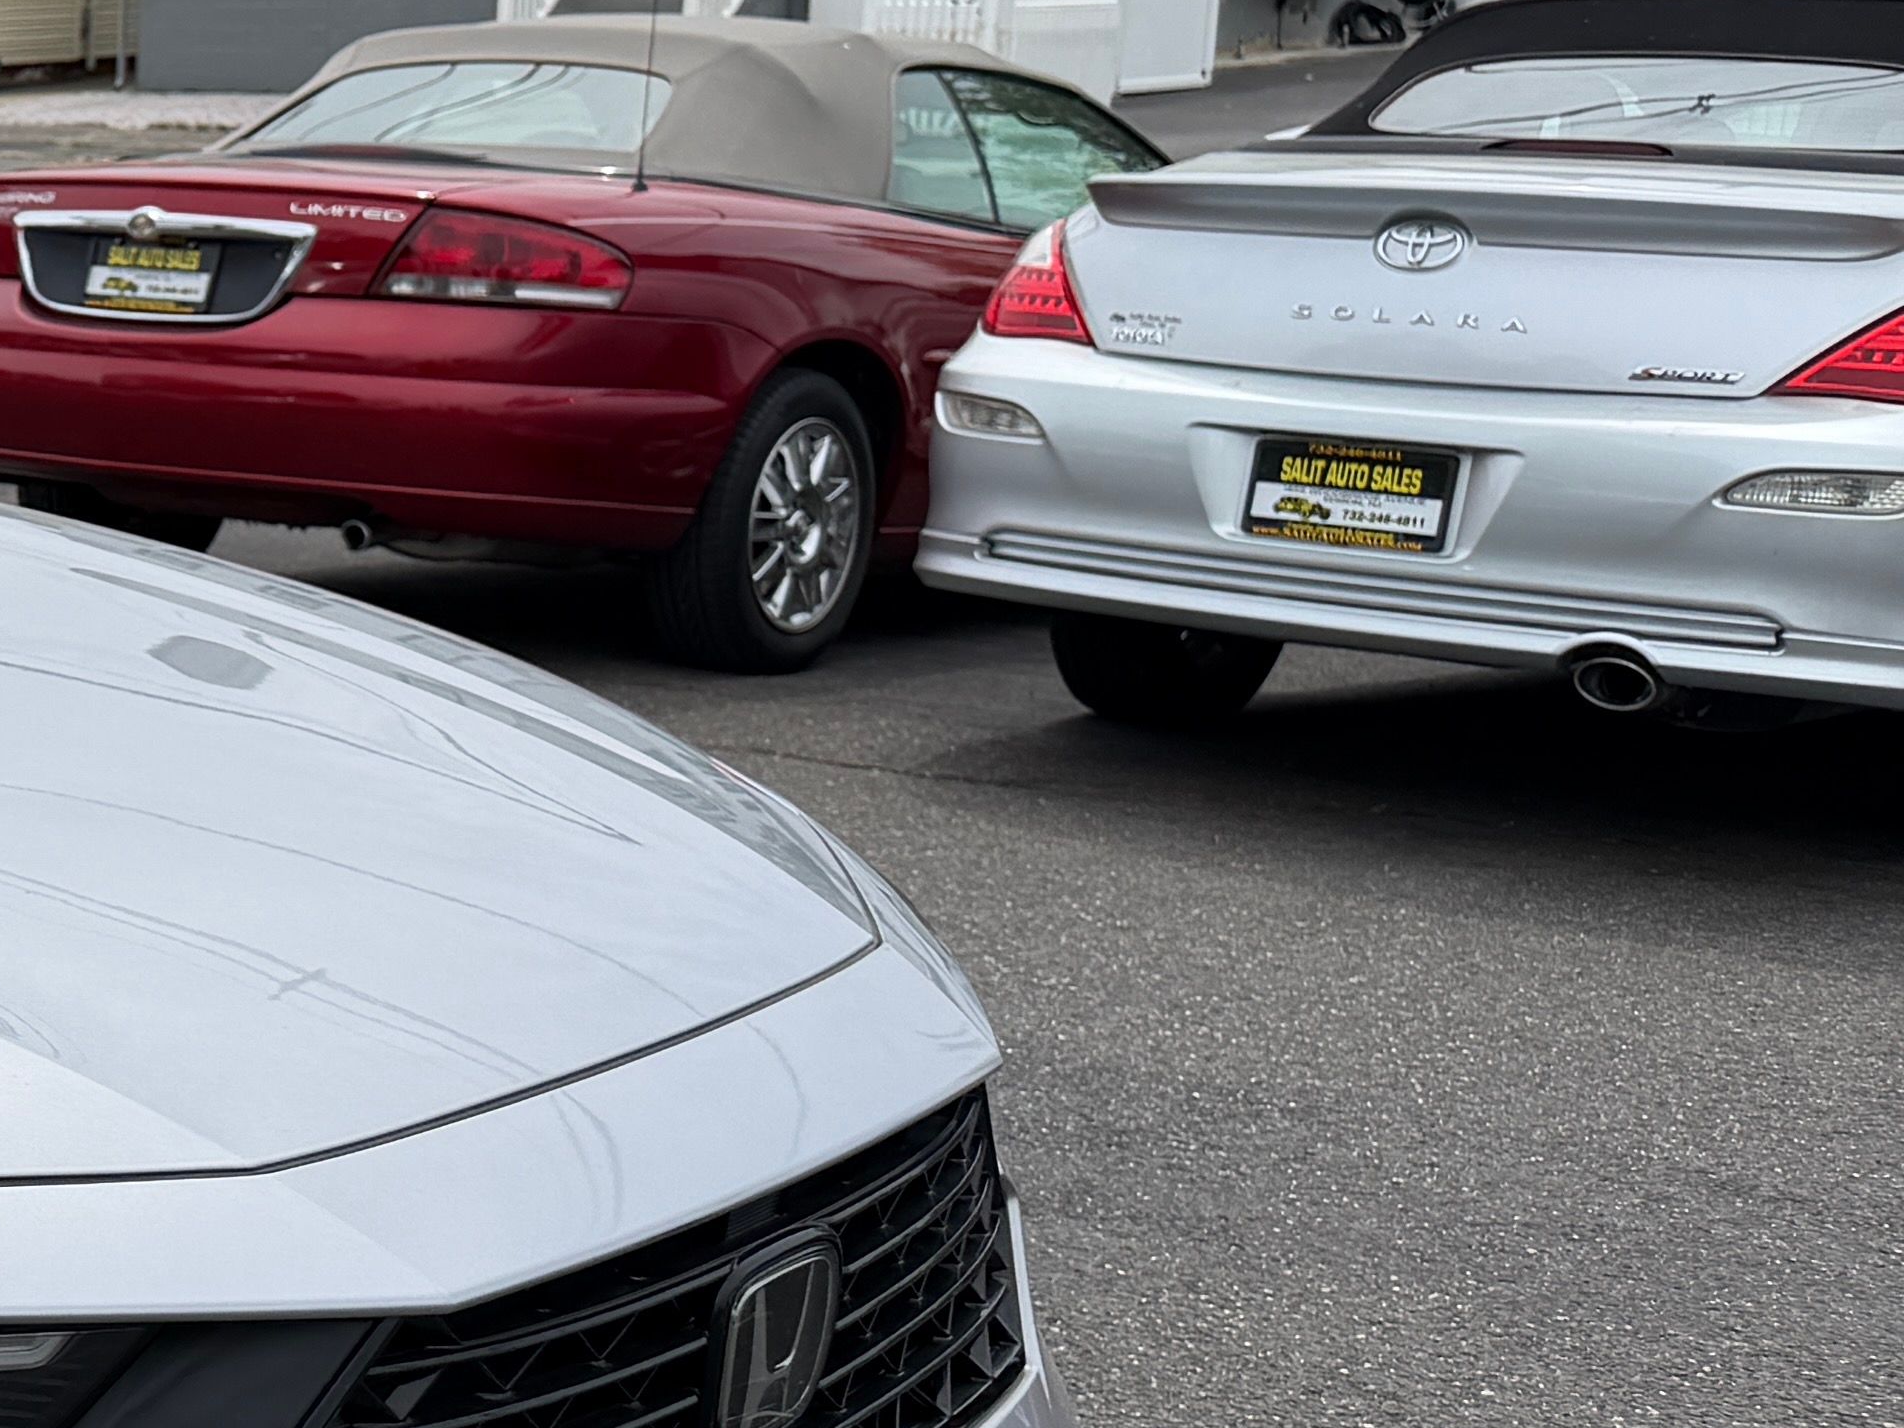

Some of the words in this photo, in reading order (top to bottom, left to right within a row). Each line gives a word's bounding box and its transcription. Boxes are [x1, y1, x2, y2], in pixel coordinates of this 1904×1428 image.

[289, 201, 407, 223] LIMITED
[1290, 302, 1528, 334] SOLARA
[1628, 365, 1746, 385] SPORT
[1280, 456, 1326, 485] SALIT
[1325, 460, 1369, 489] AUTO
[1371, 465, 1423, 496] SALES
